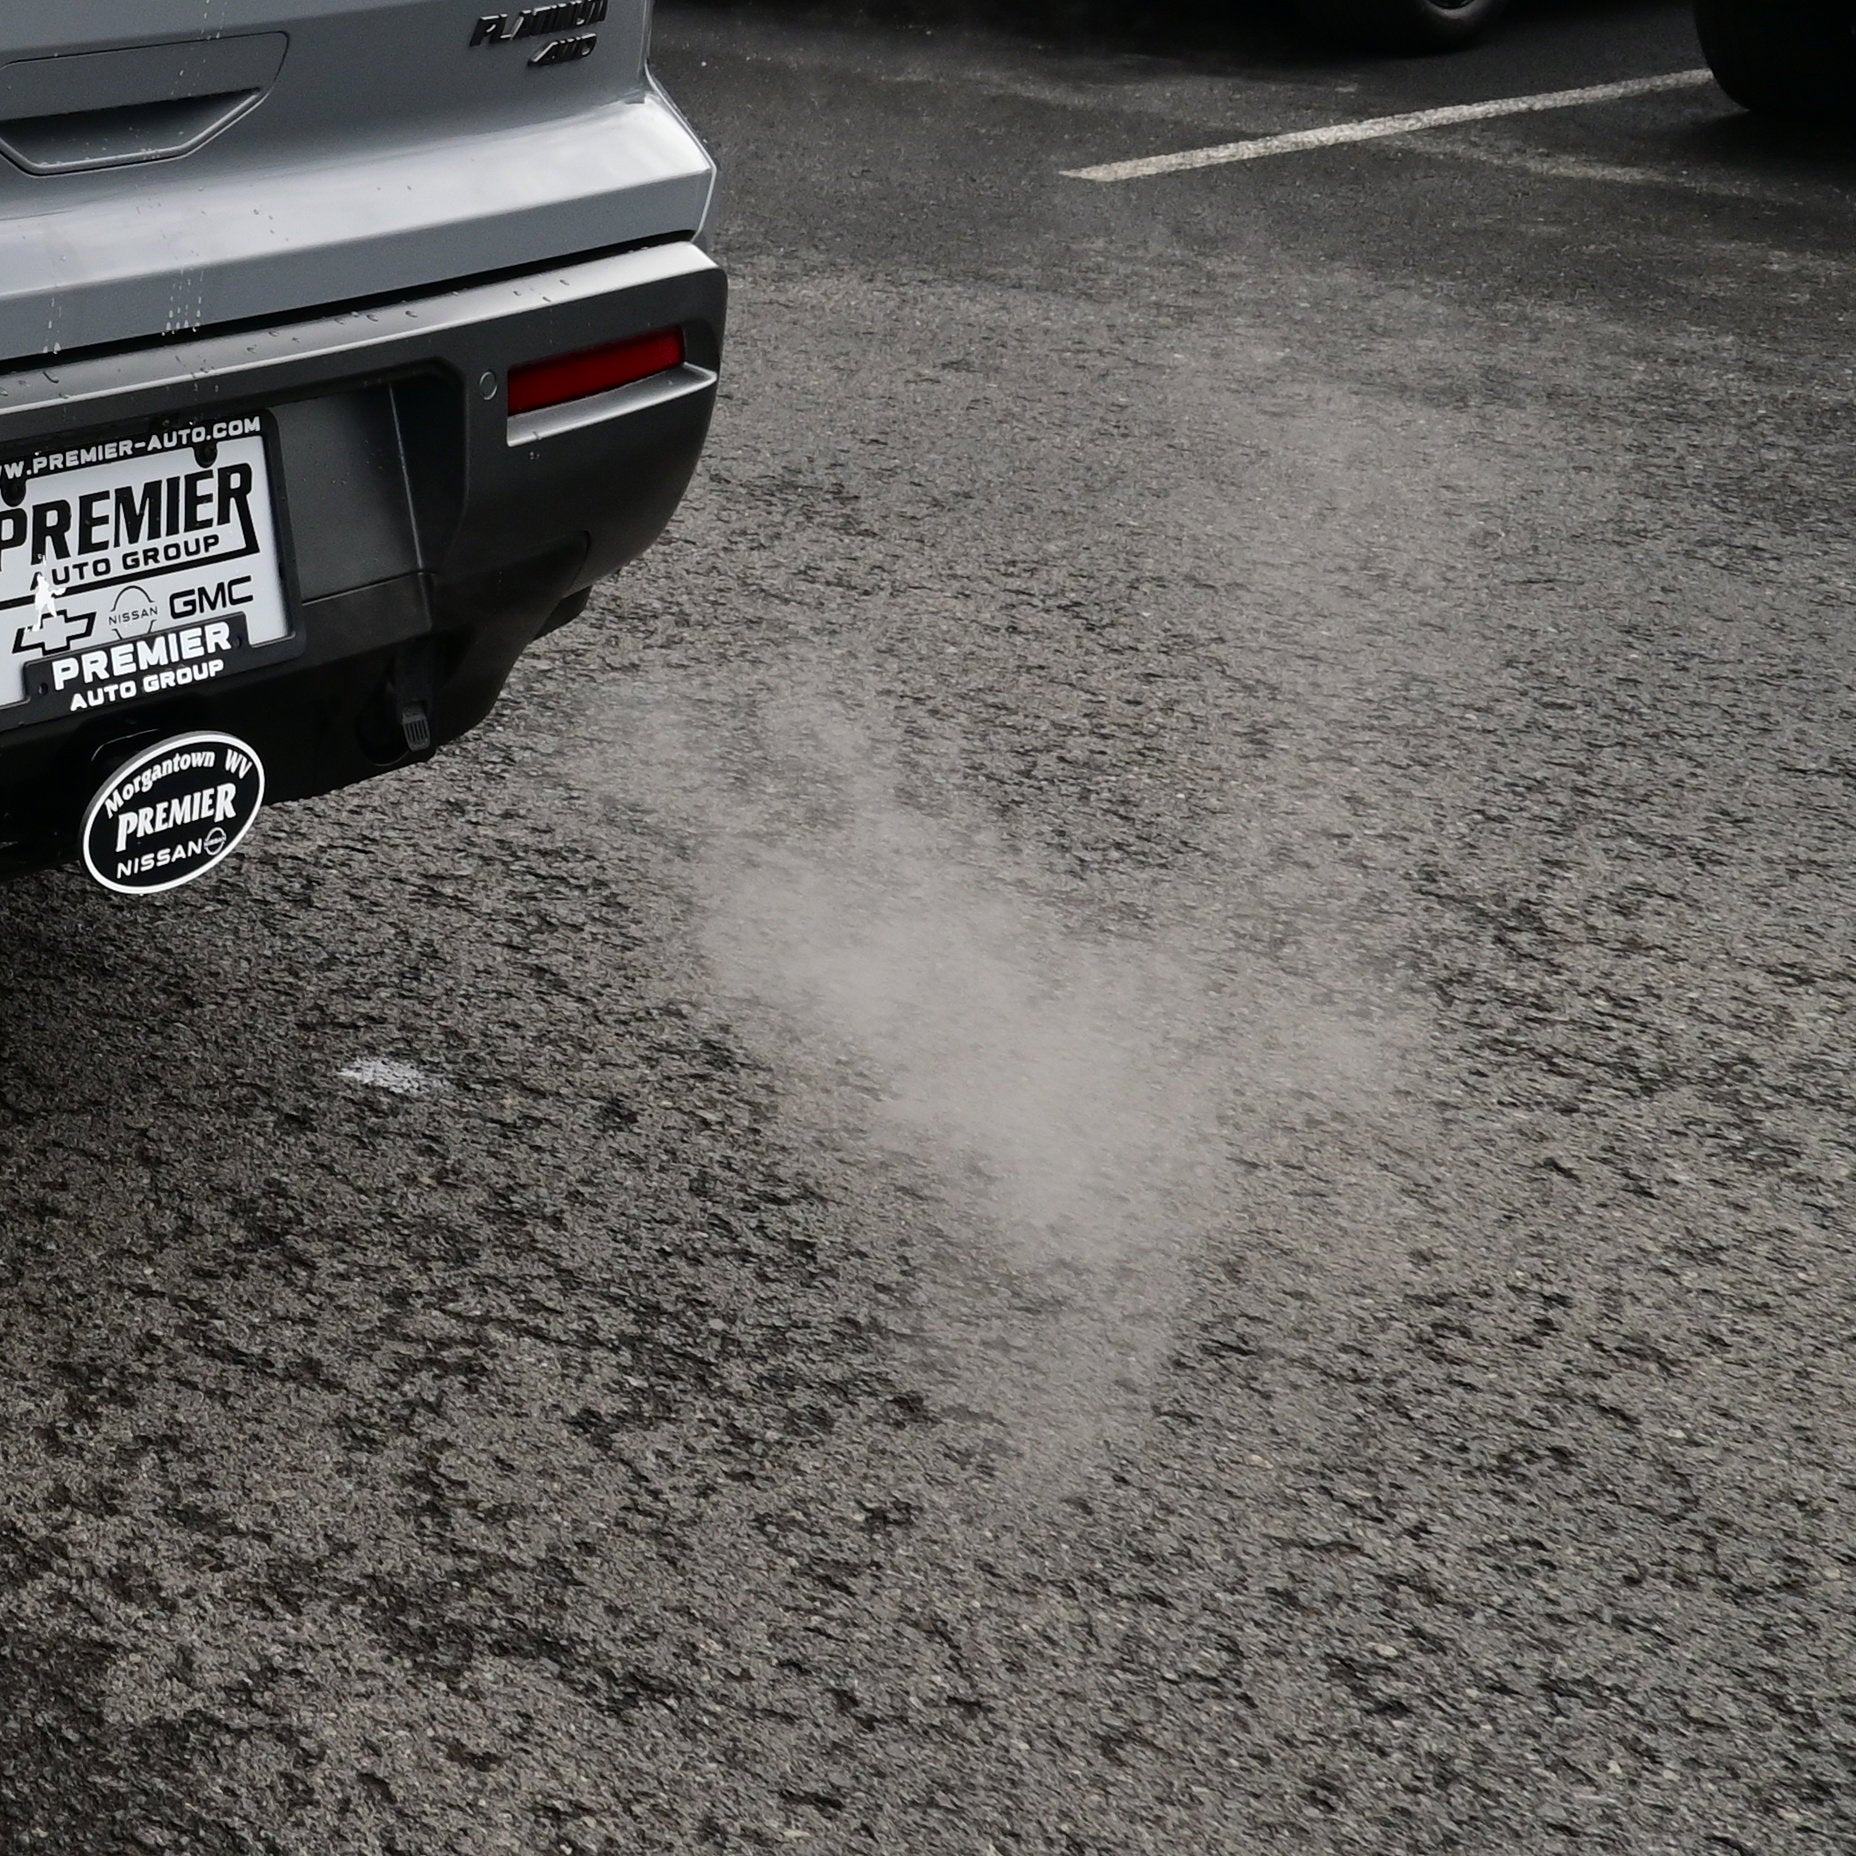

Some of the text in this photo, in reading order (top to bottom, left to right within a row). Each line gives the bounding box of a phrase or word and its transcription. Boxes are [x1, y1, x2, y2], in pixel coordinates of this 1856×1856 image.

[122, 534, 221, 570] GROUP
[108, 606, 158, 626] NISSAN
[169, 575, 255, 620] GMC
[52, 621, 232, 691] PREMIER
[70, 658, 225, 712] AUTO GROUP
[104, 749, 254, 819] Morgantown WV
[116, 781, 237, 852] PREMIER
[116, 837, 203, 879] NISSAN
